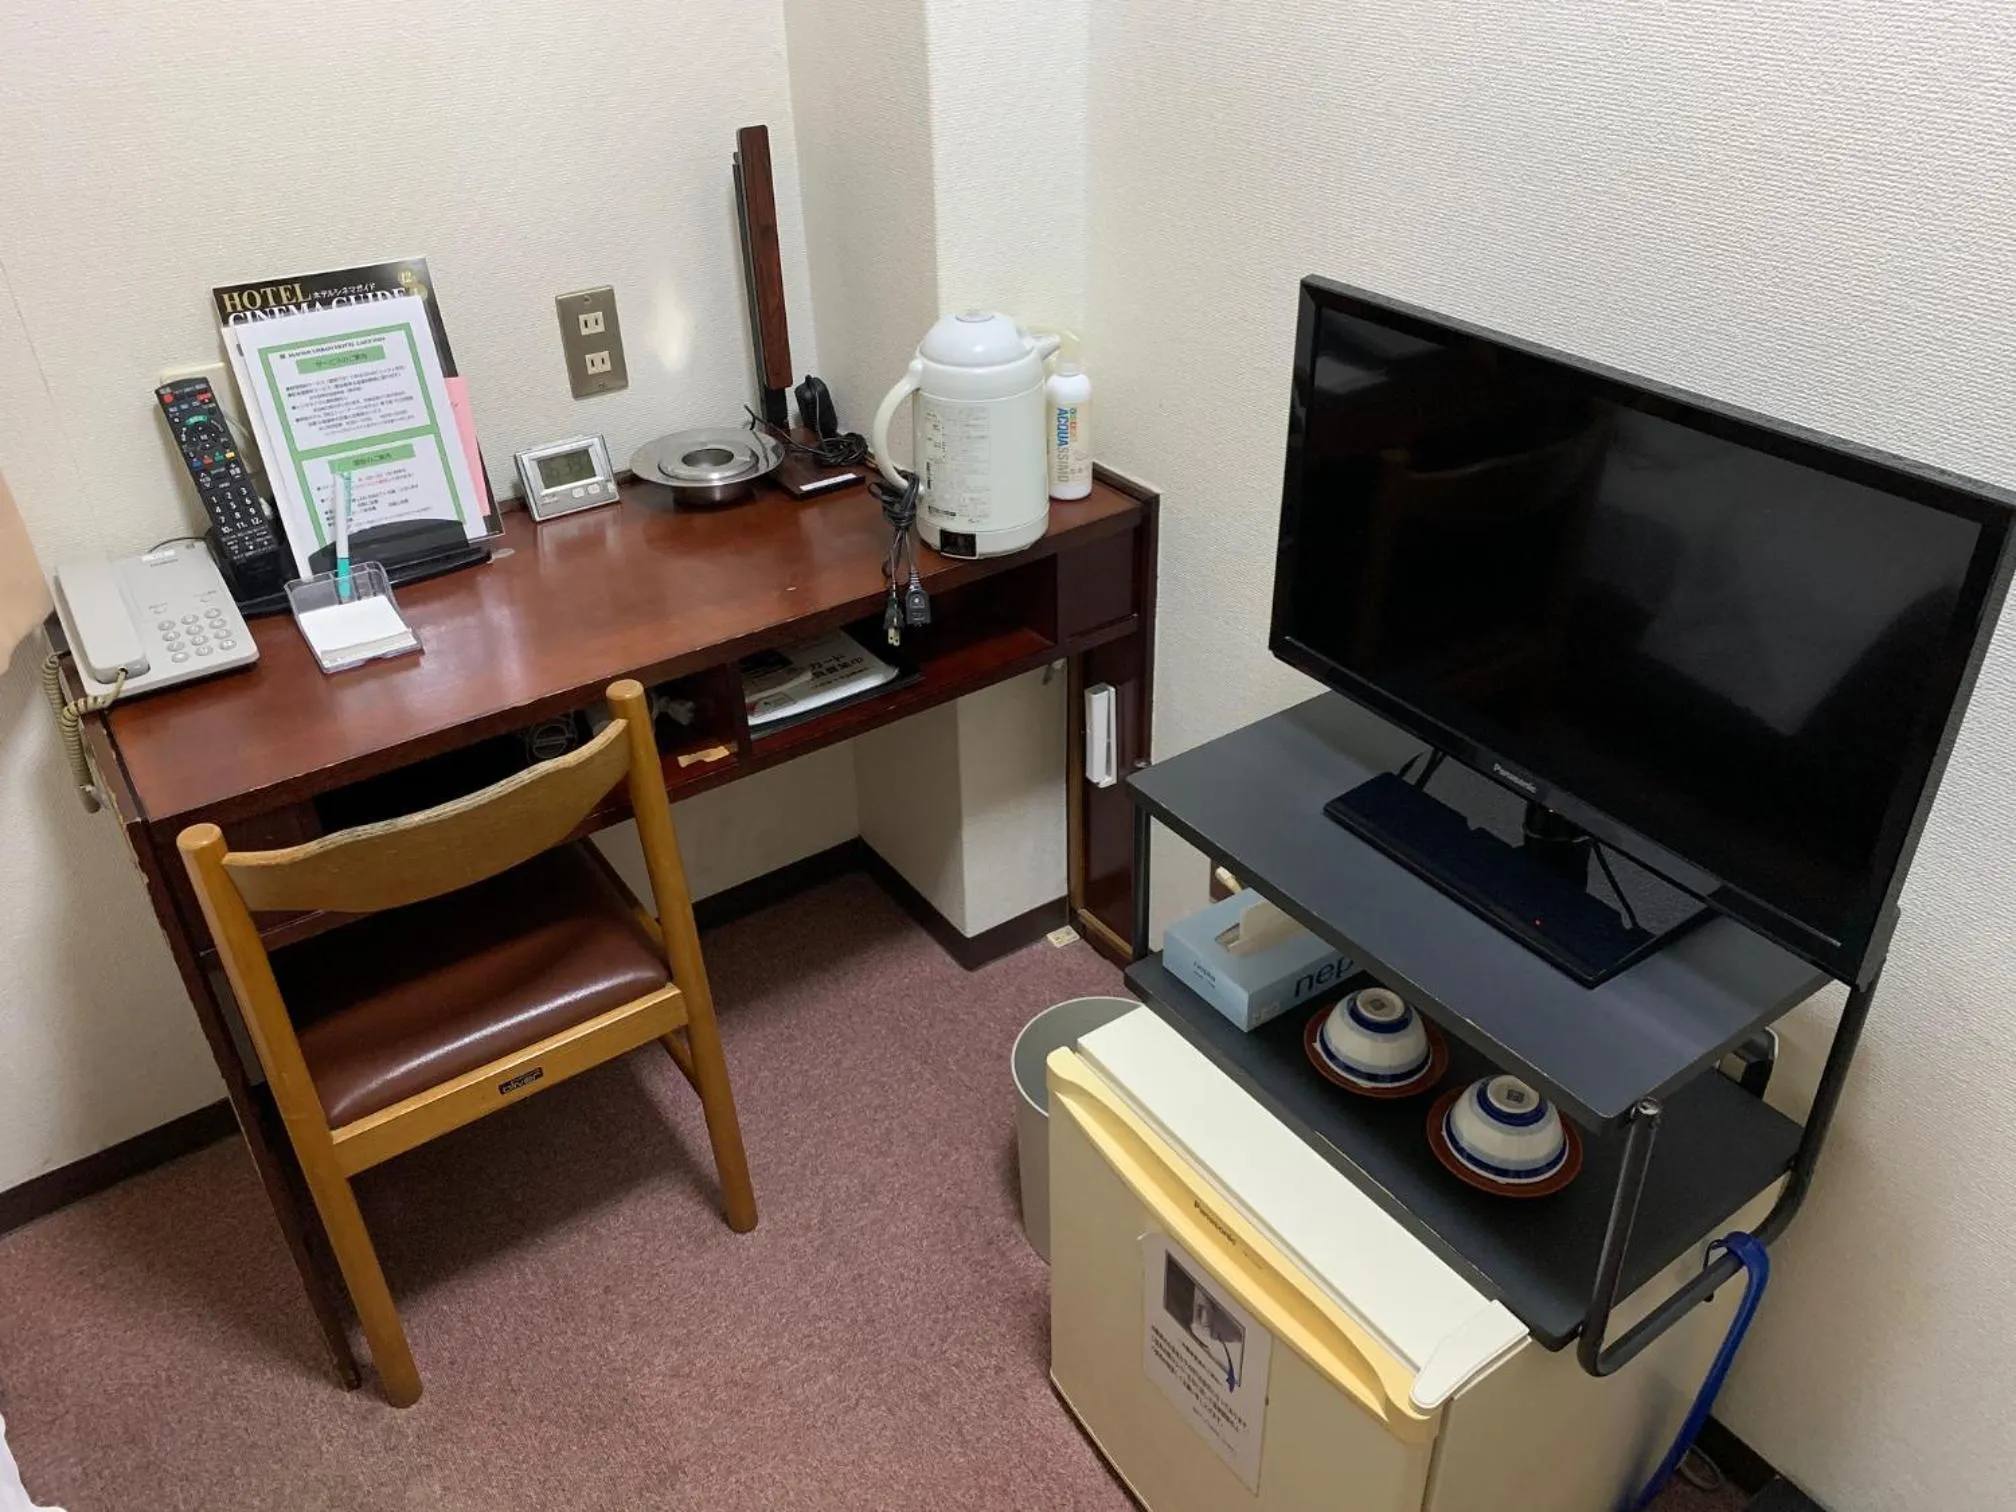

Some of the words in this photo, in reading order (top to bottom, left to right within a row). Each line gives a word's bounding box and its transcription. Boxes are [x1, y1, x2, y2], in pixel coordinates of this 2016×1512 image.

[222, 283, 312, 313] HOTEL
[312, 281, 377, 300] ホテルシネマガイド
